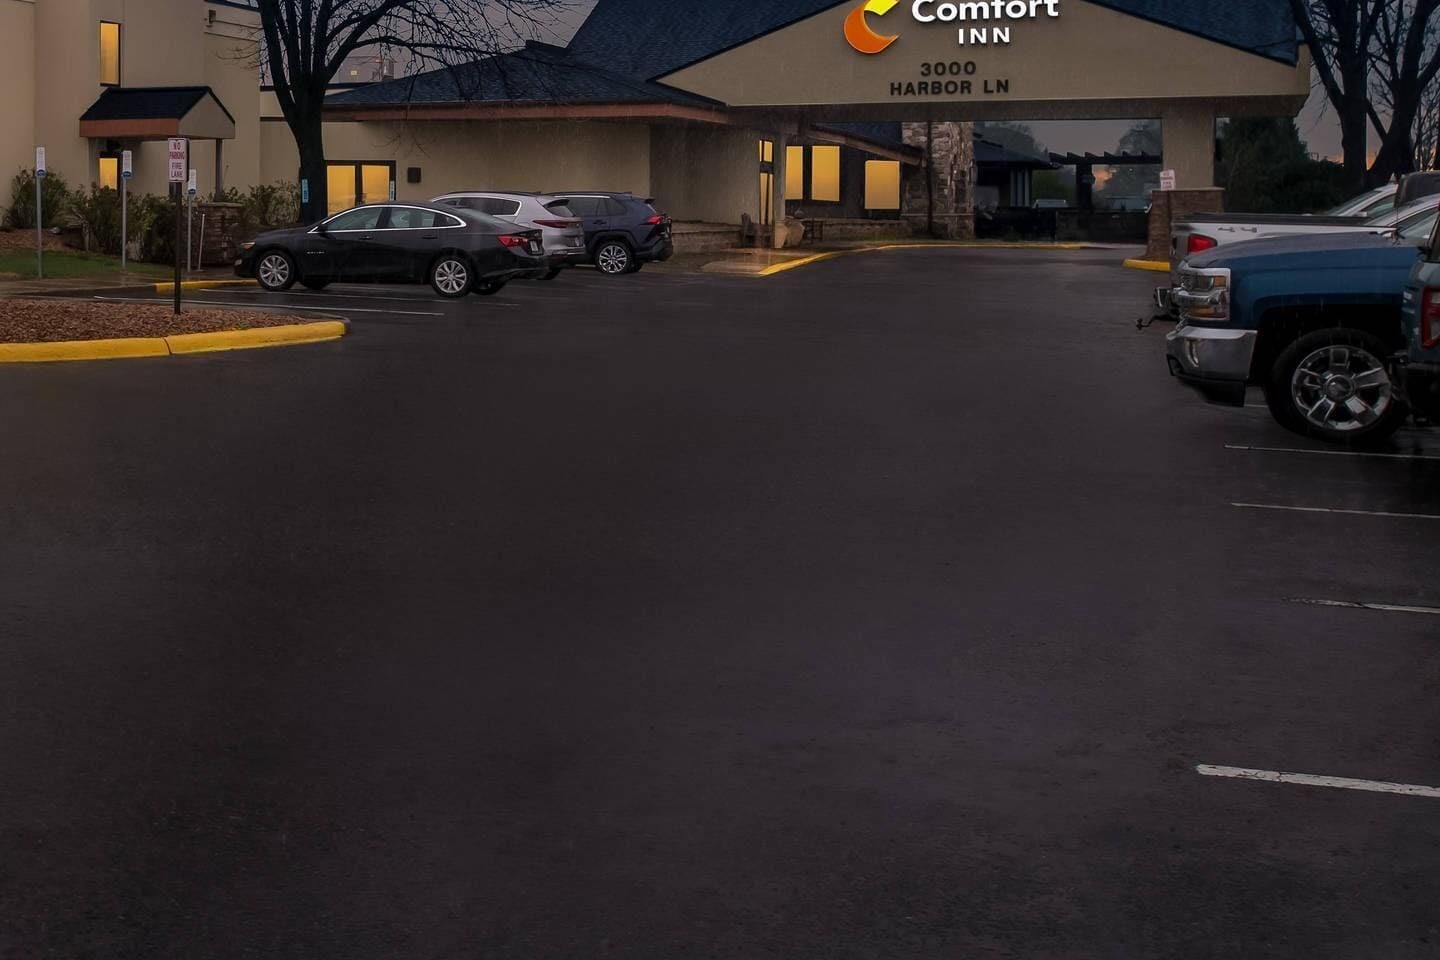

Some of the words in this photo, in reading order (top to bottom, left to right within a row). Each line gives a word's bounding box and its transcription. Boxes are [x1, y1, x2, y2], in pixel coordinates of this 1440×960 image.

[959, 27, 1010, 44] INN
[920, 61, 976, 77] 3000
[890, 80, 972, 96] HARBOR
[984, 79, 1009, 93] LN
[173, 142, 181, 151] NO
